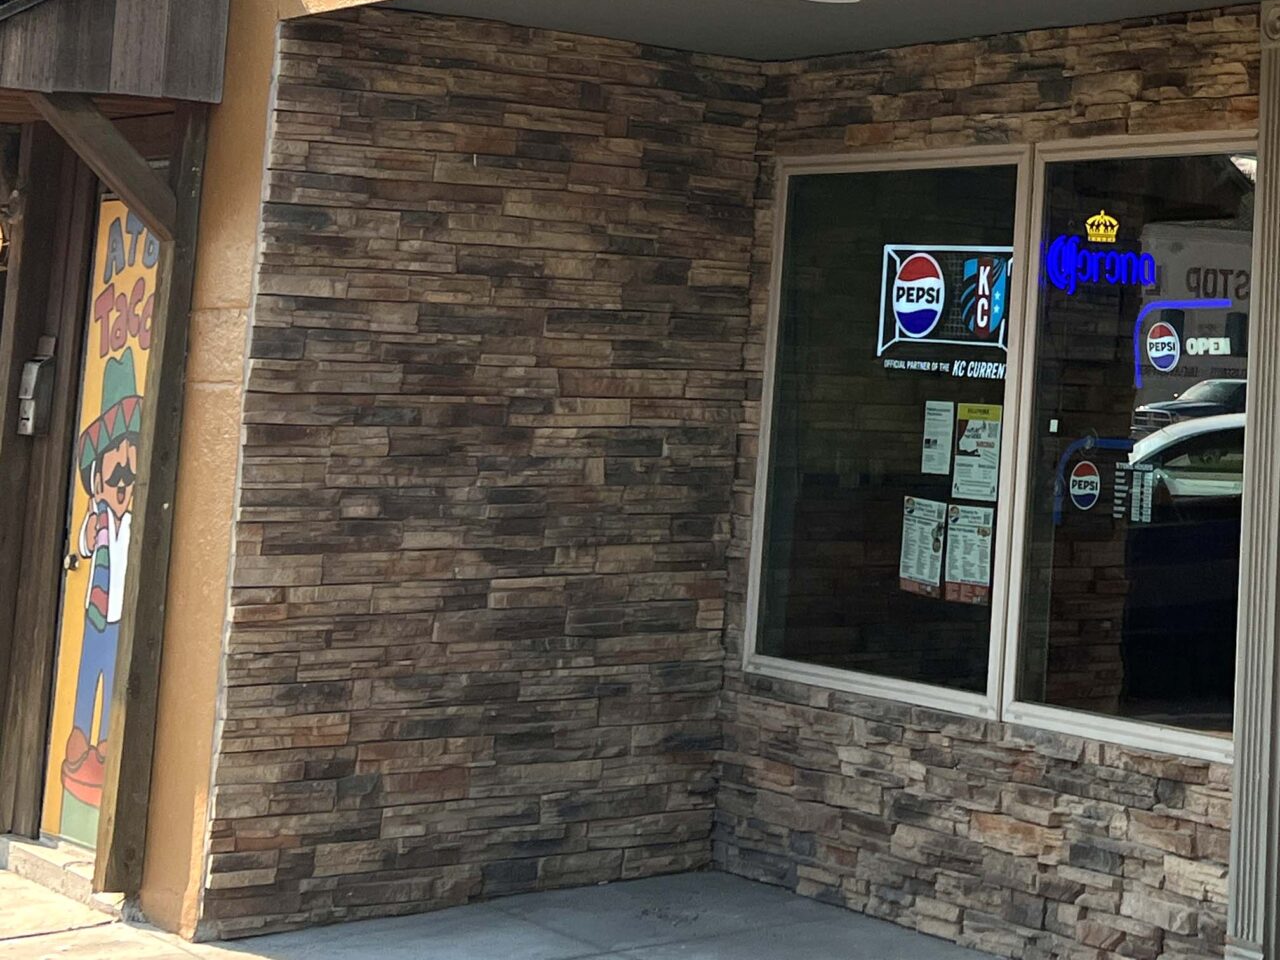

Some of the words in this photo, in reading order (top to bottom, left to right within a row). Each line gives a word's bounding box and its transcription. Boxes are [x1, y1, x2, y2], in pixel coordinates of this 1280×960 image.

[1046, 235, 1156, 295] Corona
[896, 287, 941, 304] PEPSI
[1149, 341, 1175, 352] PEPSI
[1186, 338, 1231, 355] OPEN
[884, 359, 906, 370] OFFICIAL
[906, 360, 931, 371] PARTNER
[931, 362, 939, 371] OF
[939, 363, 950, 372] THE
[952, 360, 966, 377] KC
[967, 360, 1007, 379] CURREN
[1072, 479, 1098, 491] PEPSI
